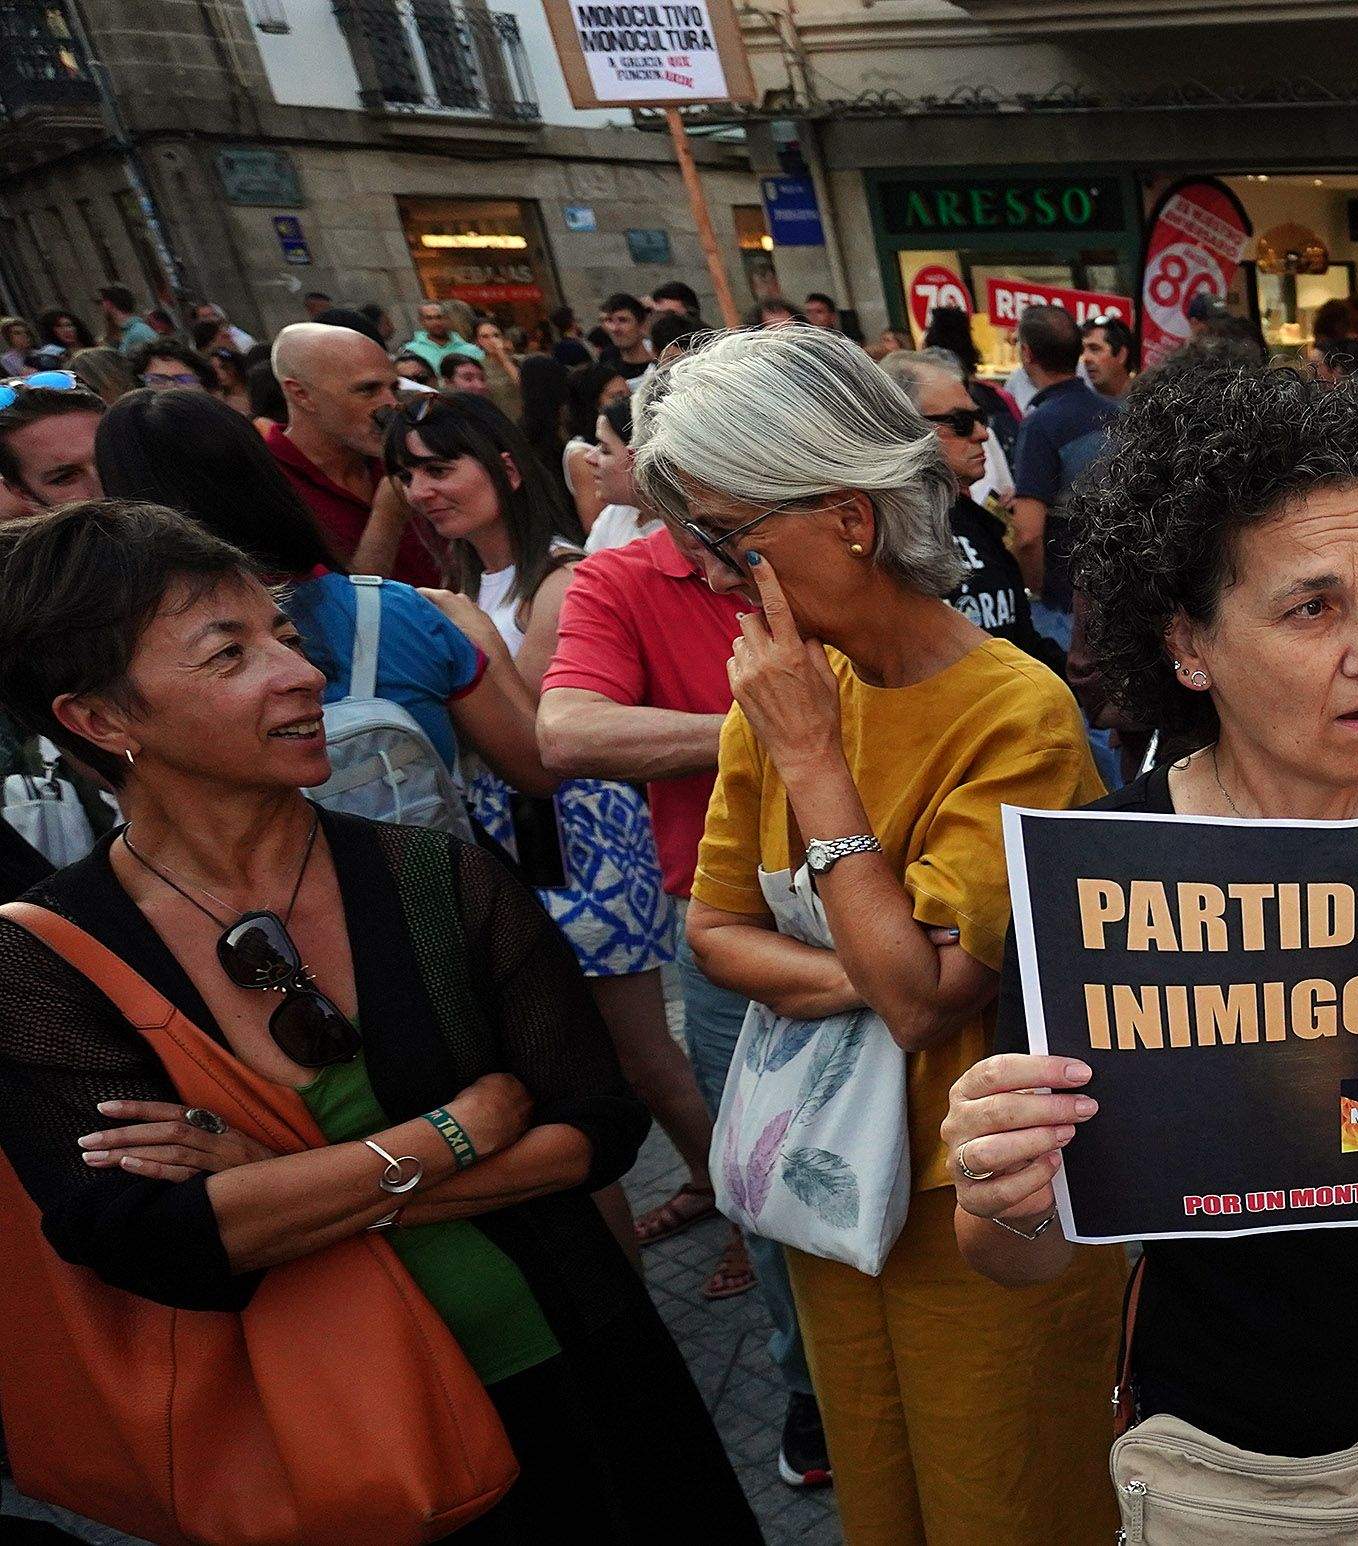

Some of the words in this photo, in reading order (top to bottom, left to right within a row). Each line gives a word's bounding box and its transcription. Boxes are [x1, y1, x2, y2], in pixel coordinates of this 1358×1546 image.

[577, 5, 703, 28] MONOCULTIVO
[580, 30, 714, 51] MONOCULTURA
[907, 185, 1092, 226] ARESSO
[1183, 1192, 1243, 1217] POR
[1246, 1189, 1286, 1212] UN
